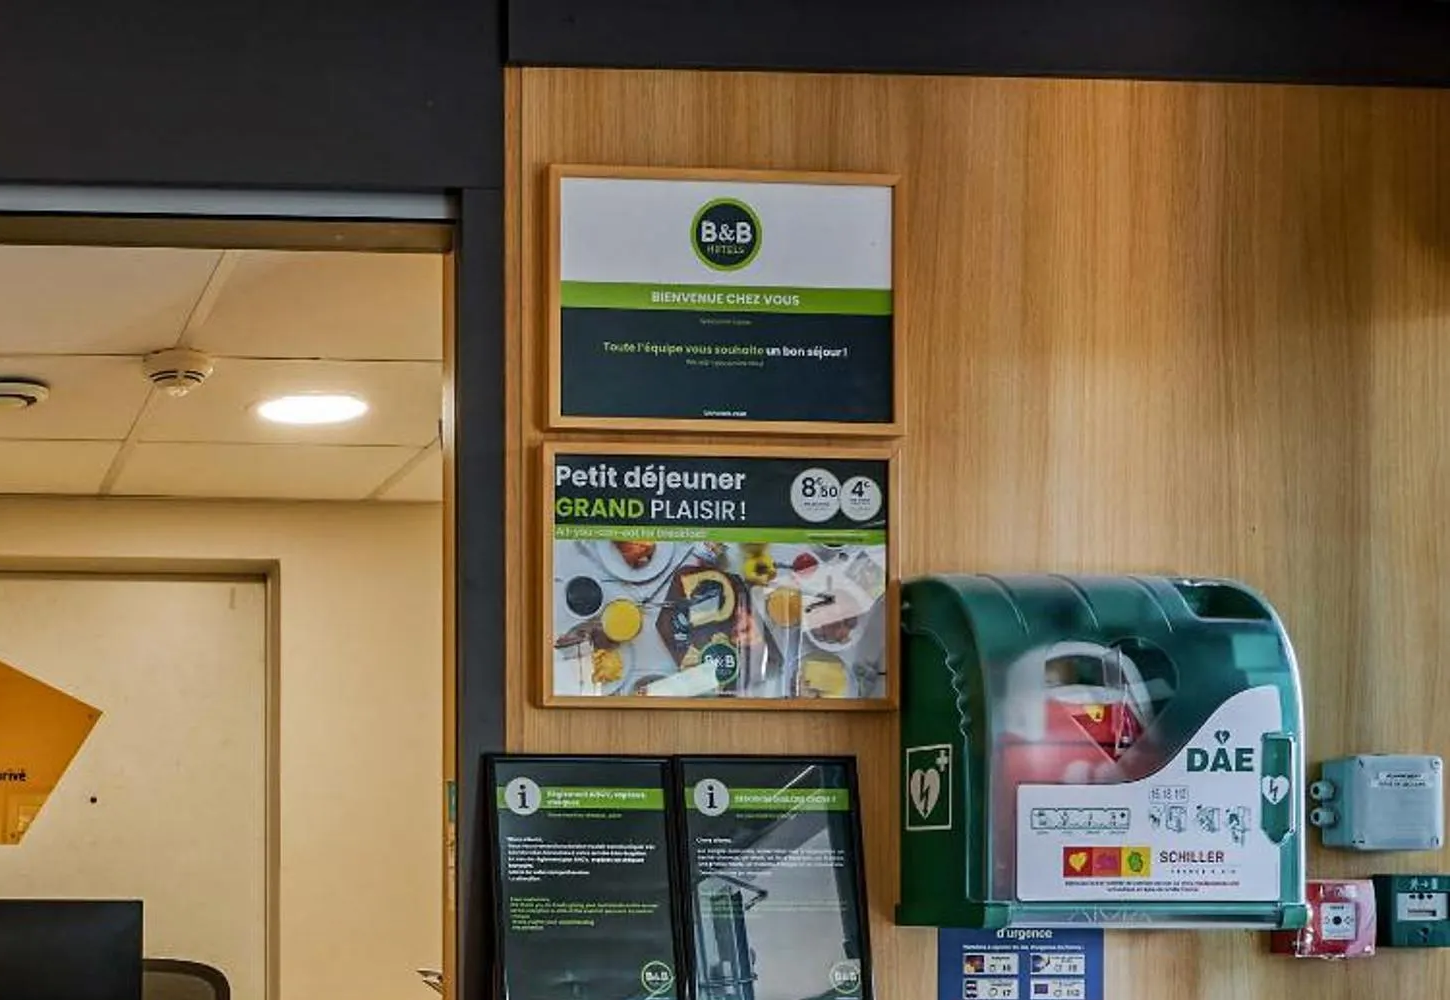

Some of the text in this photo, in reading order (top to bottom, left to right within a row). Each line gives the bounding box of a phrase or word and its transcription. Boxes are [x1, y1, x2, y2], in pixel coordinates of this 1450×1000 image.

[701, 220, 753, 244] B&B
[651, 291, 800, 306] BIENVENUE CHEZ VOUS
[602, 341, 636, 353] Toute
[637, 341, 683, 356] l'équipe
[685, 345, 712, 355] vous
[714, 344, 764, 356] souhaite
[766, 346, 781, 357] un
[782, 345, 805, 357] bon
[555, 464, 747, 497] Petit déjeuner
[555, 498, 644, 518] GRAND
[650, 499, 736, 520] PLAISIR
[1186, 747, 1254, 772] DAE
[1159, 850, 1225, 863] SCHILLER
[996, 928, 1053, 940] d'urgence
